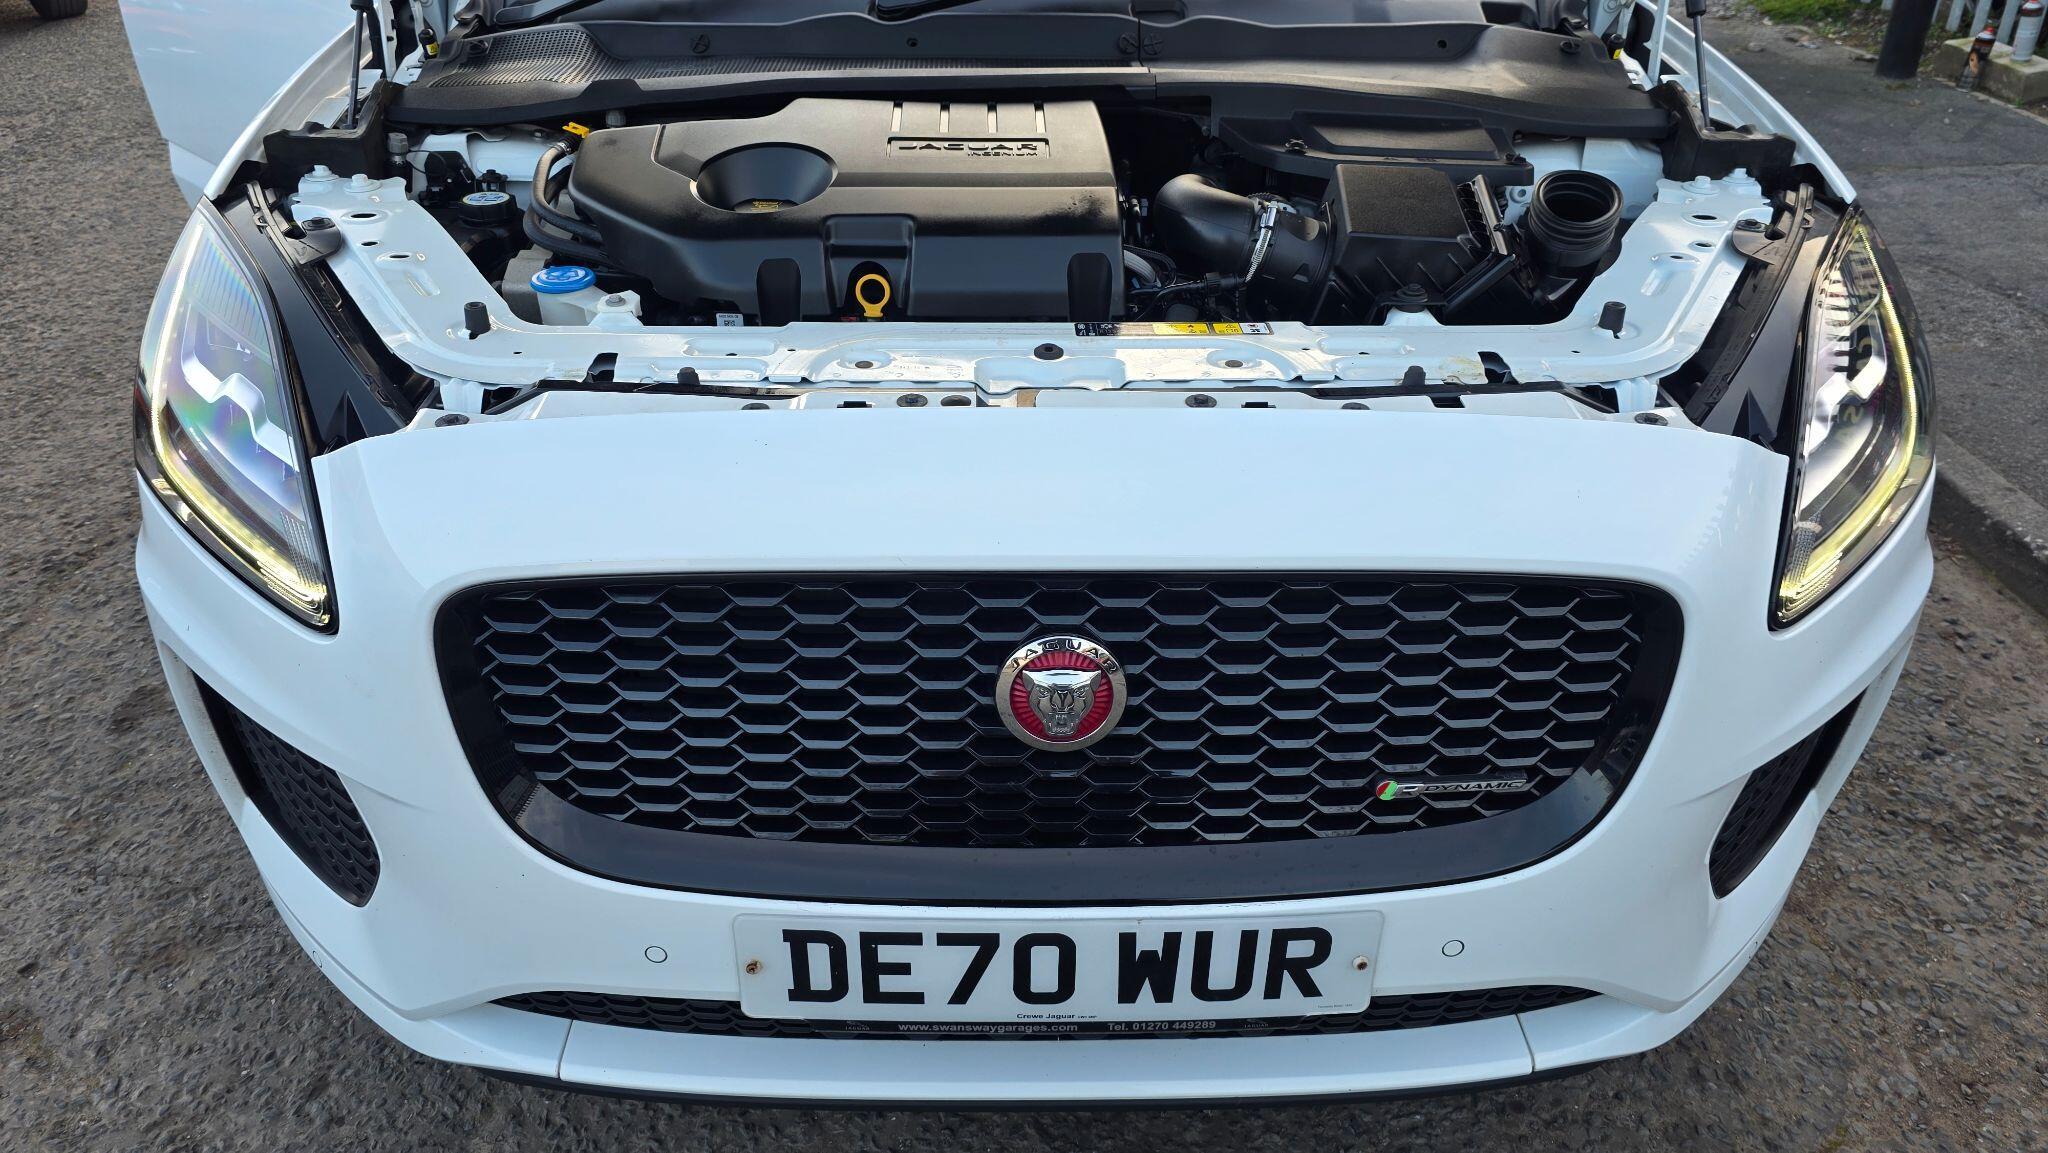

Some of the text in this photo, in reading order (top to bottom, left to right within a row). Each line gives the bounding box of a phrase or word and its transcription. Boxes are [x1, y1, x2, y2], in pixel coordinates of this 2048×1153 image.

[898, 143, 1038, 151] JAGUAR
[1010, 639, 1117, 674] JAGUAR
[1424, 780, 1526, 792] DYNAMIC
[782, 927, 1333, 1005] DE70 WUR
[897, 1020, 1217, 1034] www.swanswaygarages.com Tel. 01270 449289
